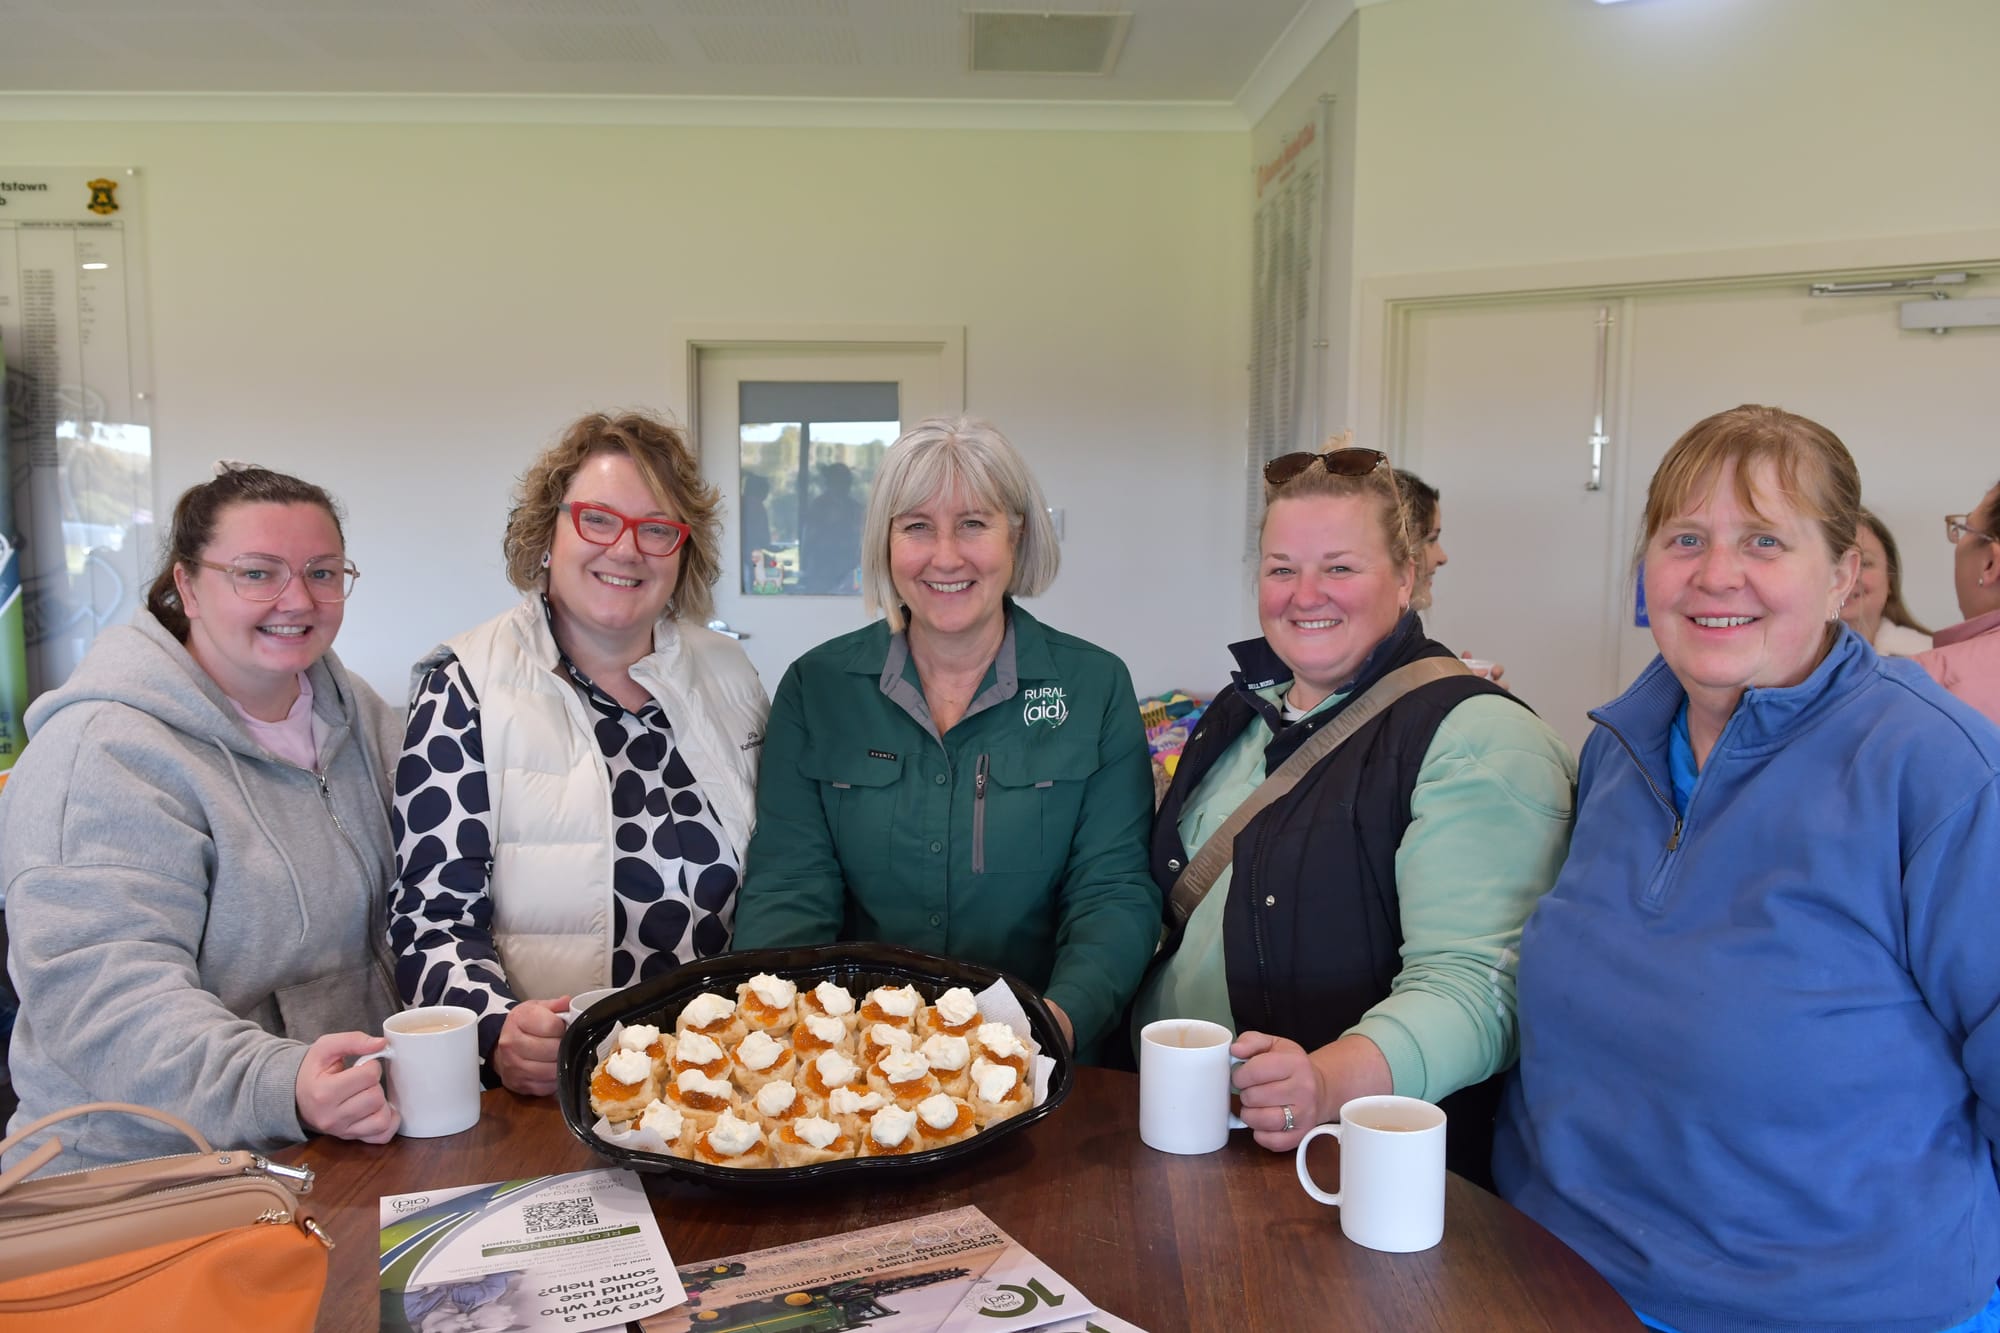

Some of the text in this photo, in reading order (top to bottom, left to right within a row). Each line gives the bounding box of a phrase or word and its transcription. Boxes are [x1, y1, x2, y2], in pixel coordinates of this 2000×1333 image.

[0, 181, 47, 191] tstown
[1024, 687, 1067, 700] RURAL
[1314, 696, 1378, 749] COUNTRY
[1183, 857, 1217, 895] ROAD
[534, 1230, 585, 1240] Assistance
[588, 1223, 623, 1232] Farmer
[842, 1214, 984, 1258] 2025
[482, 1238, 522, 1248] Support
[503, 1230, 621, 1253] REGISTER NOW
[877, 1233, 998, 1263] for 10 strong years
[735, 1238, 1004, 1300] Supporting farmers & rural communities
[538, 1268, 656, 1297] some help?
[559, 1277, 659, 1302] could use
[540, 1286, 664, 1316] farmer who
[583, 1305, 622, 1320] you
[628, 1294, 664, 1310] Are
